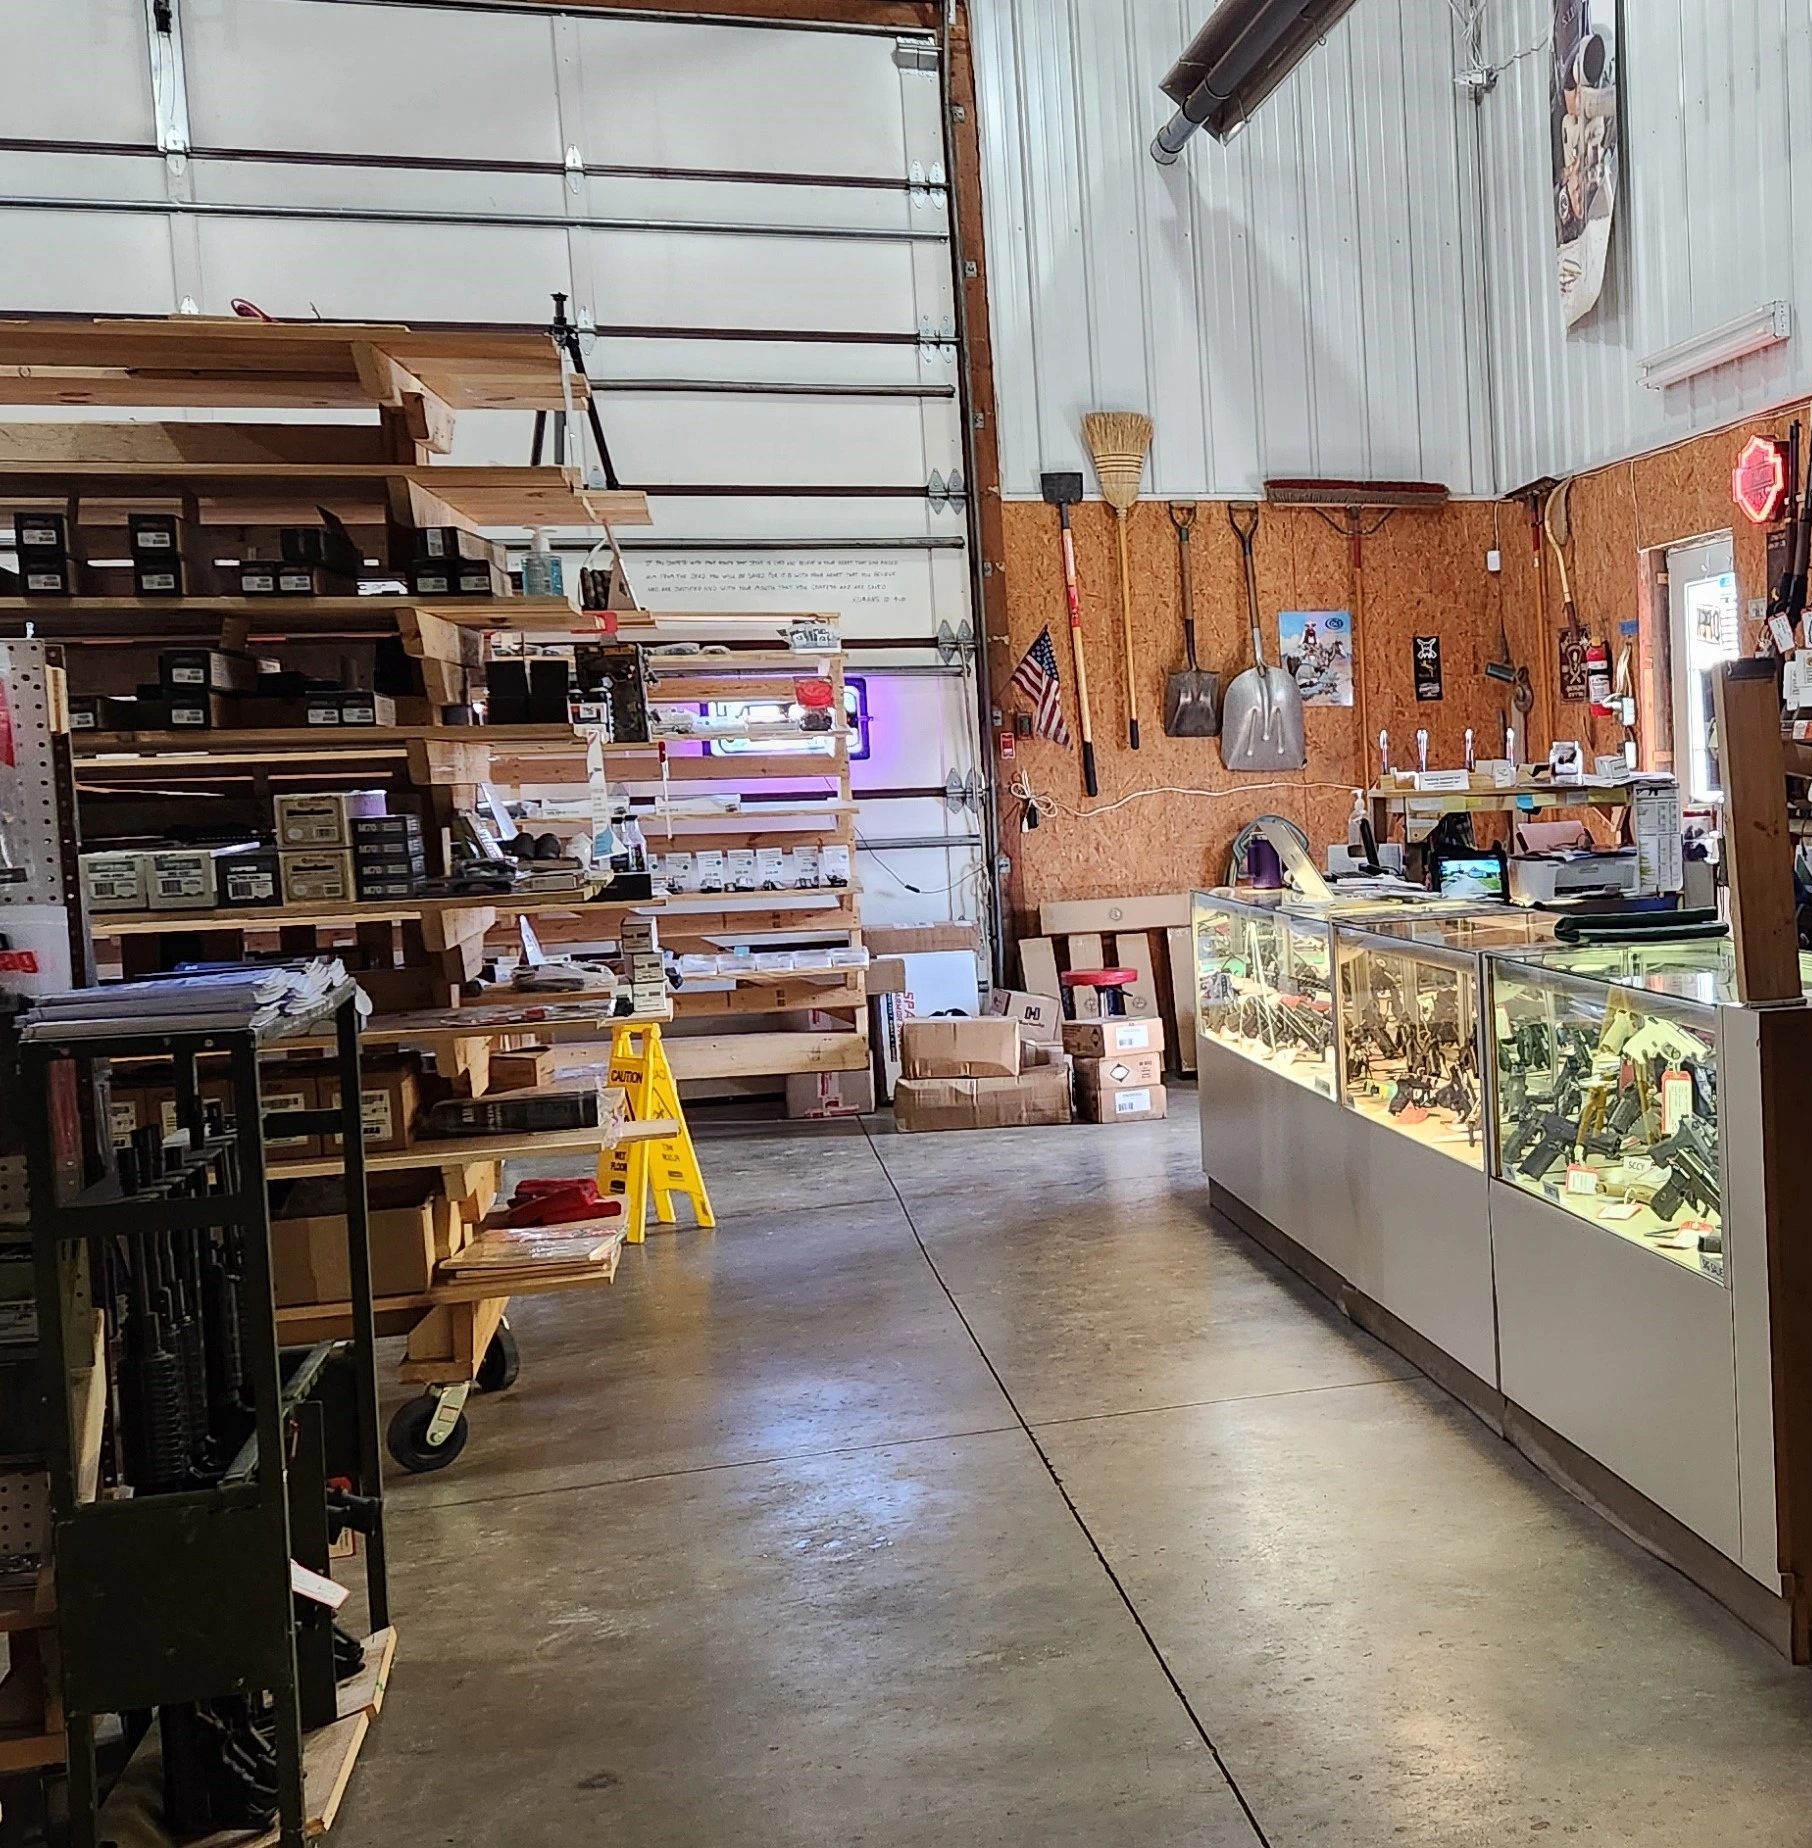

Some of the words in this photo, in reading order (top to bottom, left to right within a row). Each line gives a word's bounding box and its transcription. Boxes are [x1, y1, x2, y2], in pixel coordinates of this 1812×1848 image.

[611, 1069, 644, 1085] CAUTION
[614, 1151, 628, 1161] WET
[610, 1162, 628, 1173] FLOOR
